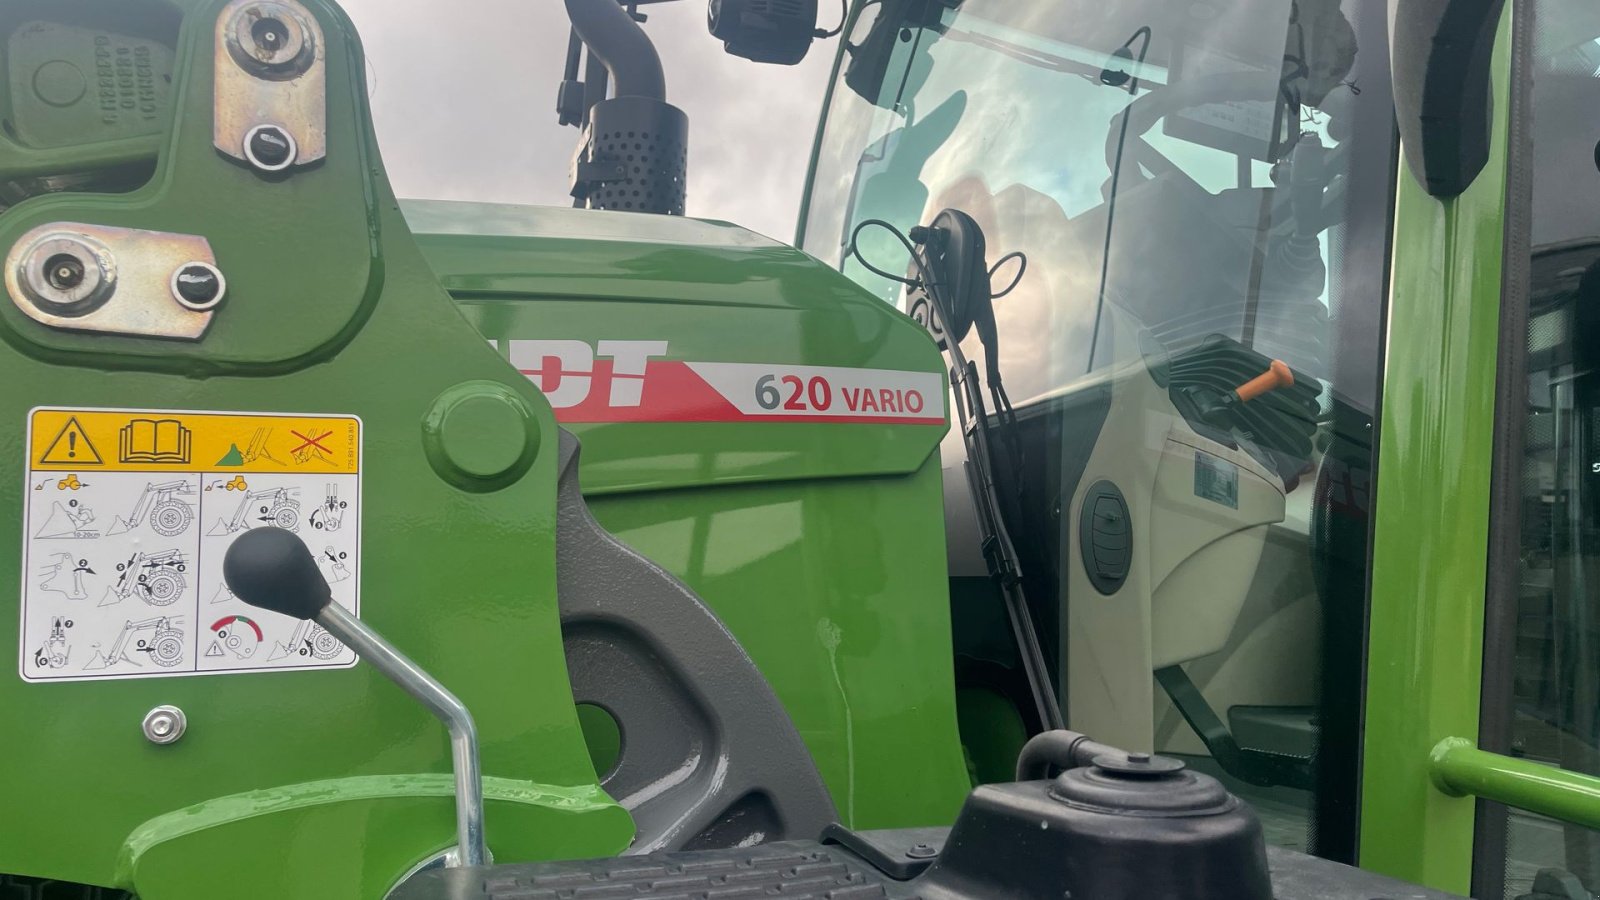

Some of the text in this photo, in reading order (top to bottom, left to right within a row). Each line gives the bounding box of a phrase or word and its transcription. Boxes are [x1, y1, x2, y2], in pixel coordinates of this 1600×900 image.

[488, 340, 668, 408] DT
[755, 374, 924, 413] 620 VARIO
